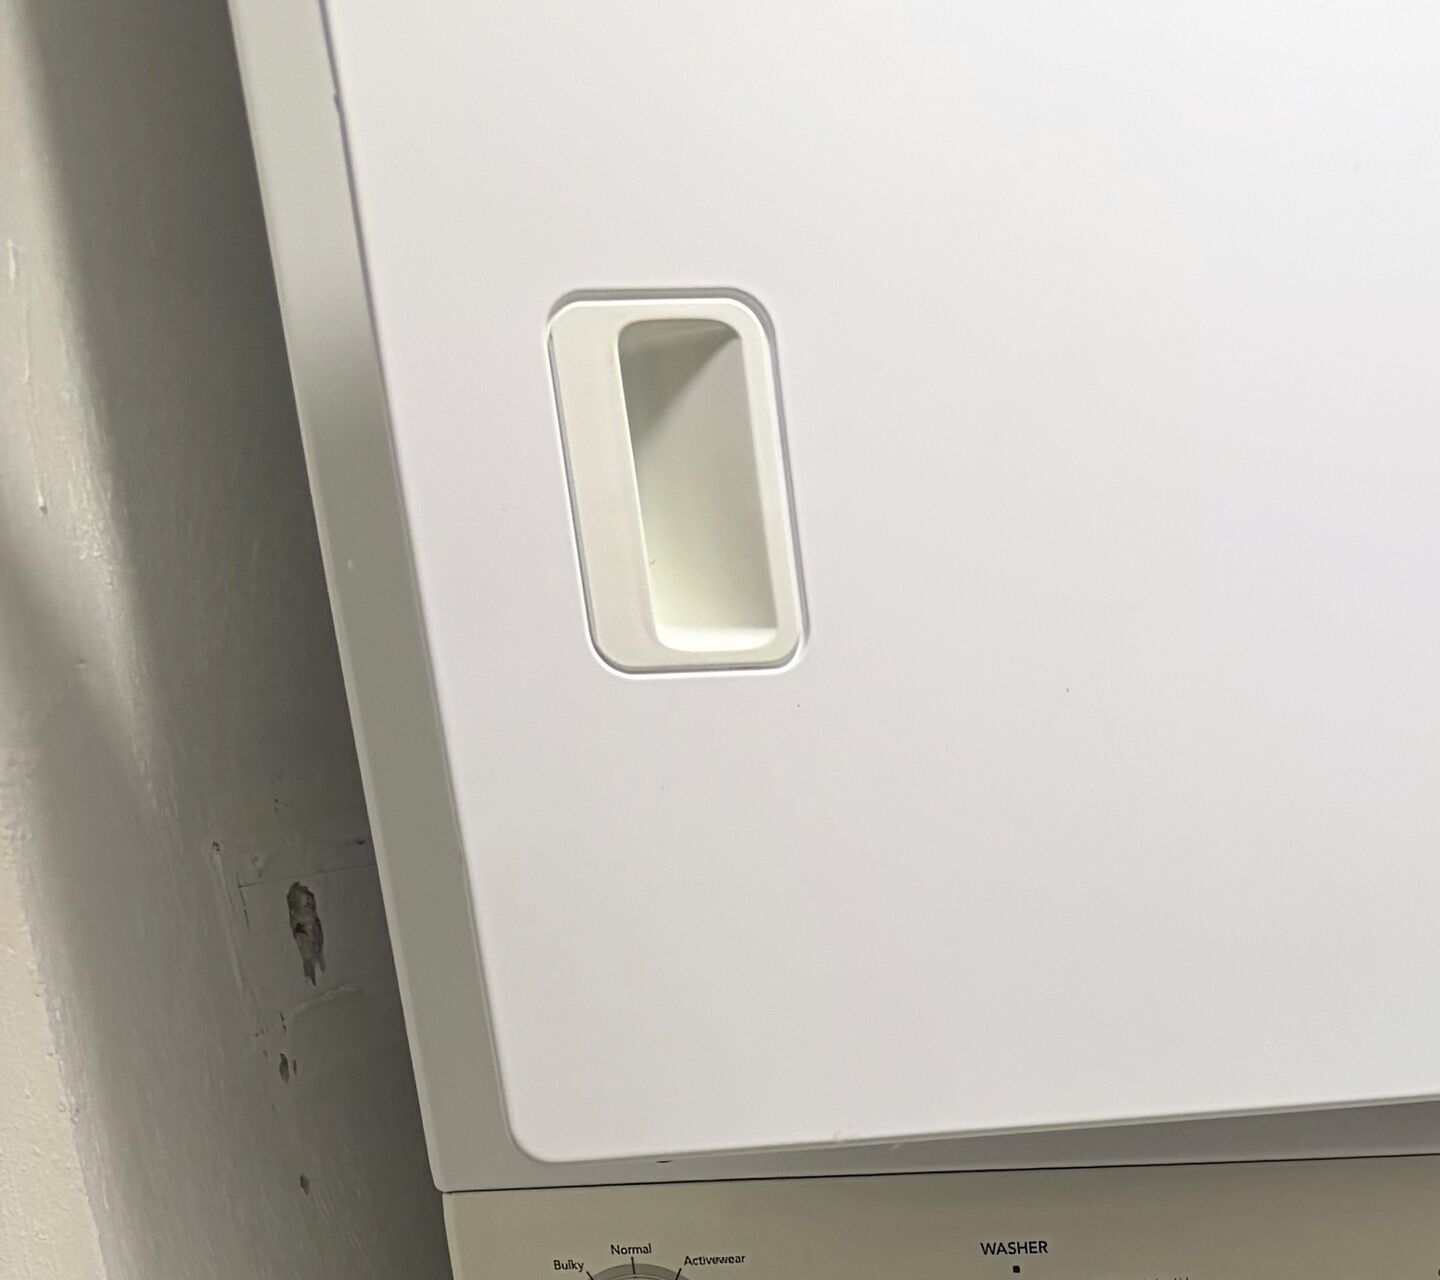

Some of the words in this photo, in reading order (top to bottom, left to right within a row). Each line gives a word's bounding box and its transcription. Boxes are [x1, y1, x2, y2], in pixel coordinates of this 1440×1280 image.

[610, 1243, 652, 1256] Normal
[980, 1241, 1048, 1255] WASHER
[553, 1260, 584, 1272] Bulky
[683, 1254, 746, 1266] Activewear
